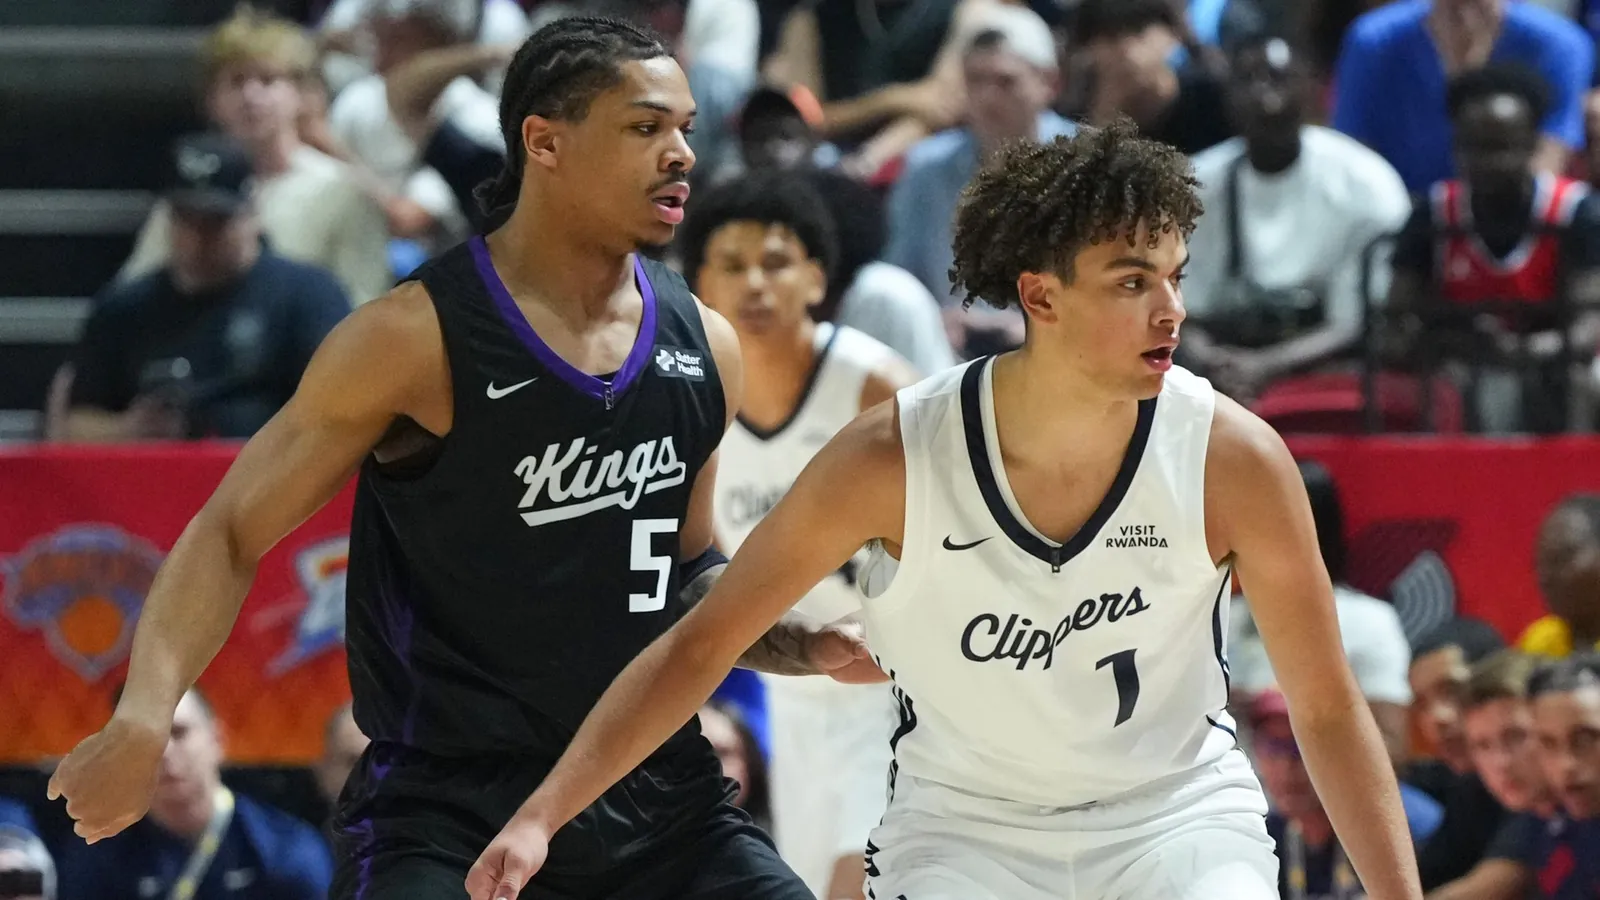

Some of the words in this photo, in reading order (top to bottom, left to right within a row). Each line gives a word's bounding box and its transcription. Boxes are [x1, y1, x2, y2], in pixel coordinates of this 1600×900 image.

[513, 436, 687, 527] Kings
[628, 518, 679, 613] 5
[1105, 537, 1169, 549] RWANDA
[1120, 525, 1156, 537] VISIT
[960, 586, 1152, 671] Clippers
[1095, 648, 1140, 728] 1
